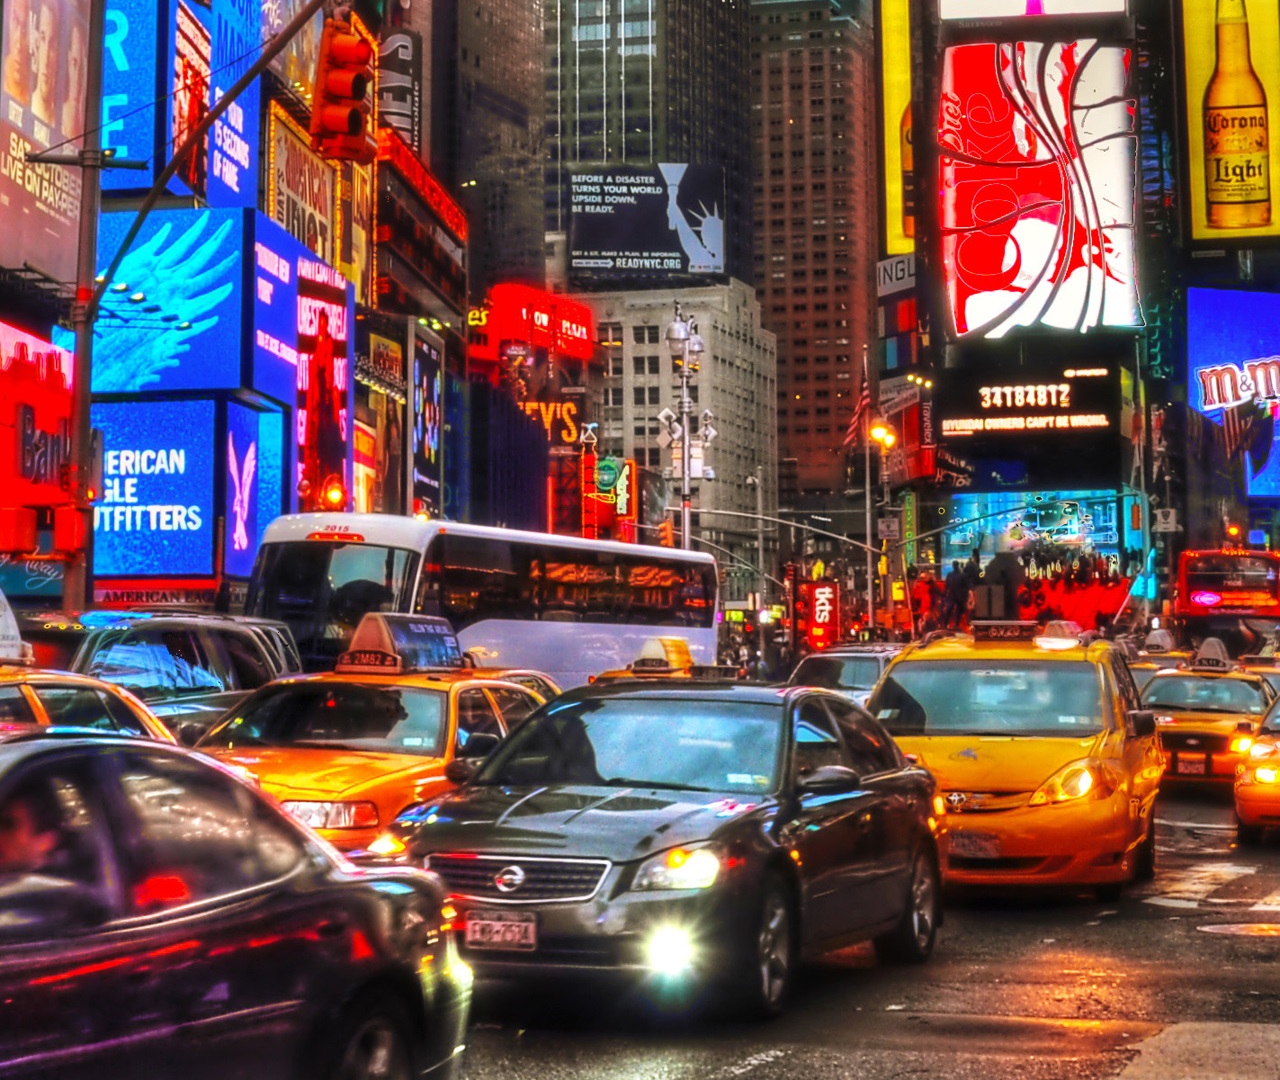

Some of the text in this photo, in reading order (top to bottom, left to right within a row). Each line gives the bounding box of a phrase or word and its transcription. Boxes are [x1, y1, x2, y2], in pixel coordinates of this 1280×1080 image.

[1207, 112, 1266, 134] Corona
[1, 151, 23, 186] LIVE
[24, 167, 41, 198] ON
[1213, 157, 1263, 183] Light
[571, 174, 656, 185] BEFORE A DISASTER
[571, 184, 663, 195] TURNS YOUR WORLD
[571, 195, 638, 205] UPSIDE DOWN,
[571, 205, 615, 214] BE READY.
[616, 258, 682, 270] READYNYC.ORG
[923, 400, 933, 445] Travelex
[324, 524, 350, 533] 2015
[103, 590, 181, 604] AMERICAN
[815, 586, 834, 624] tkts
[354, 652, 381, 665] 2M82
